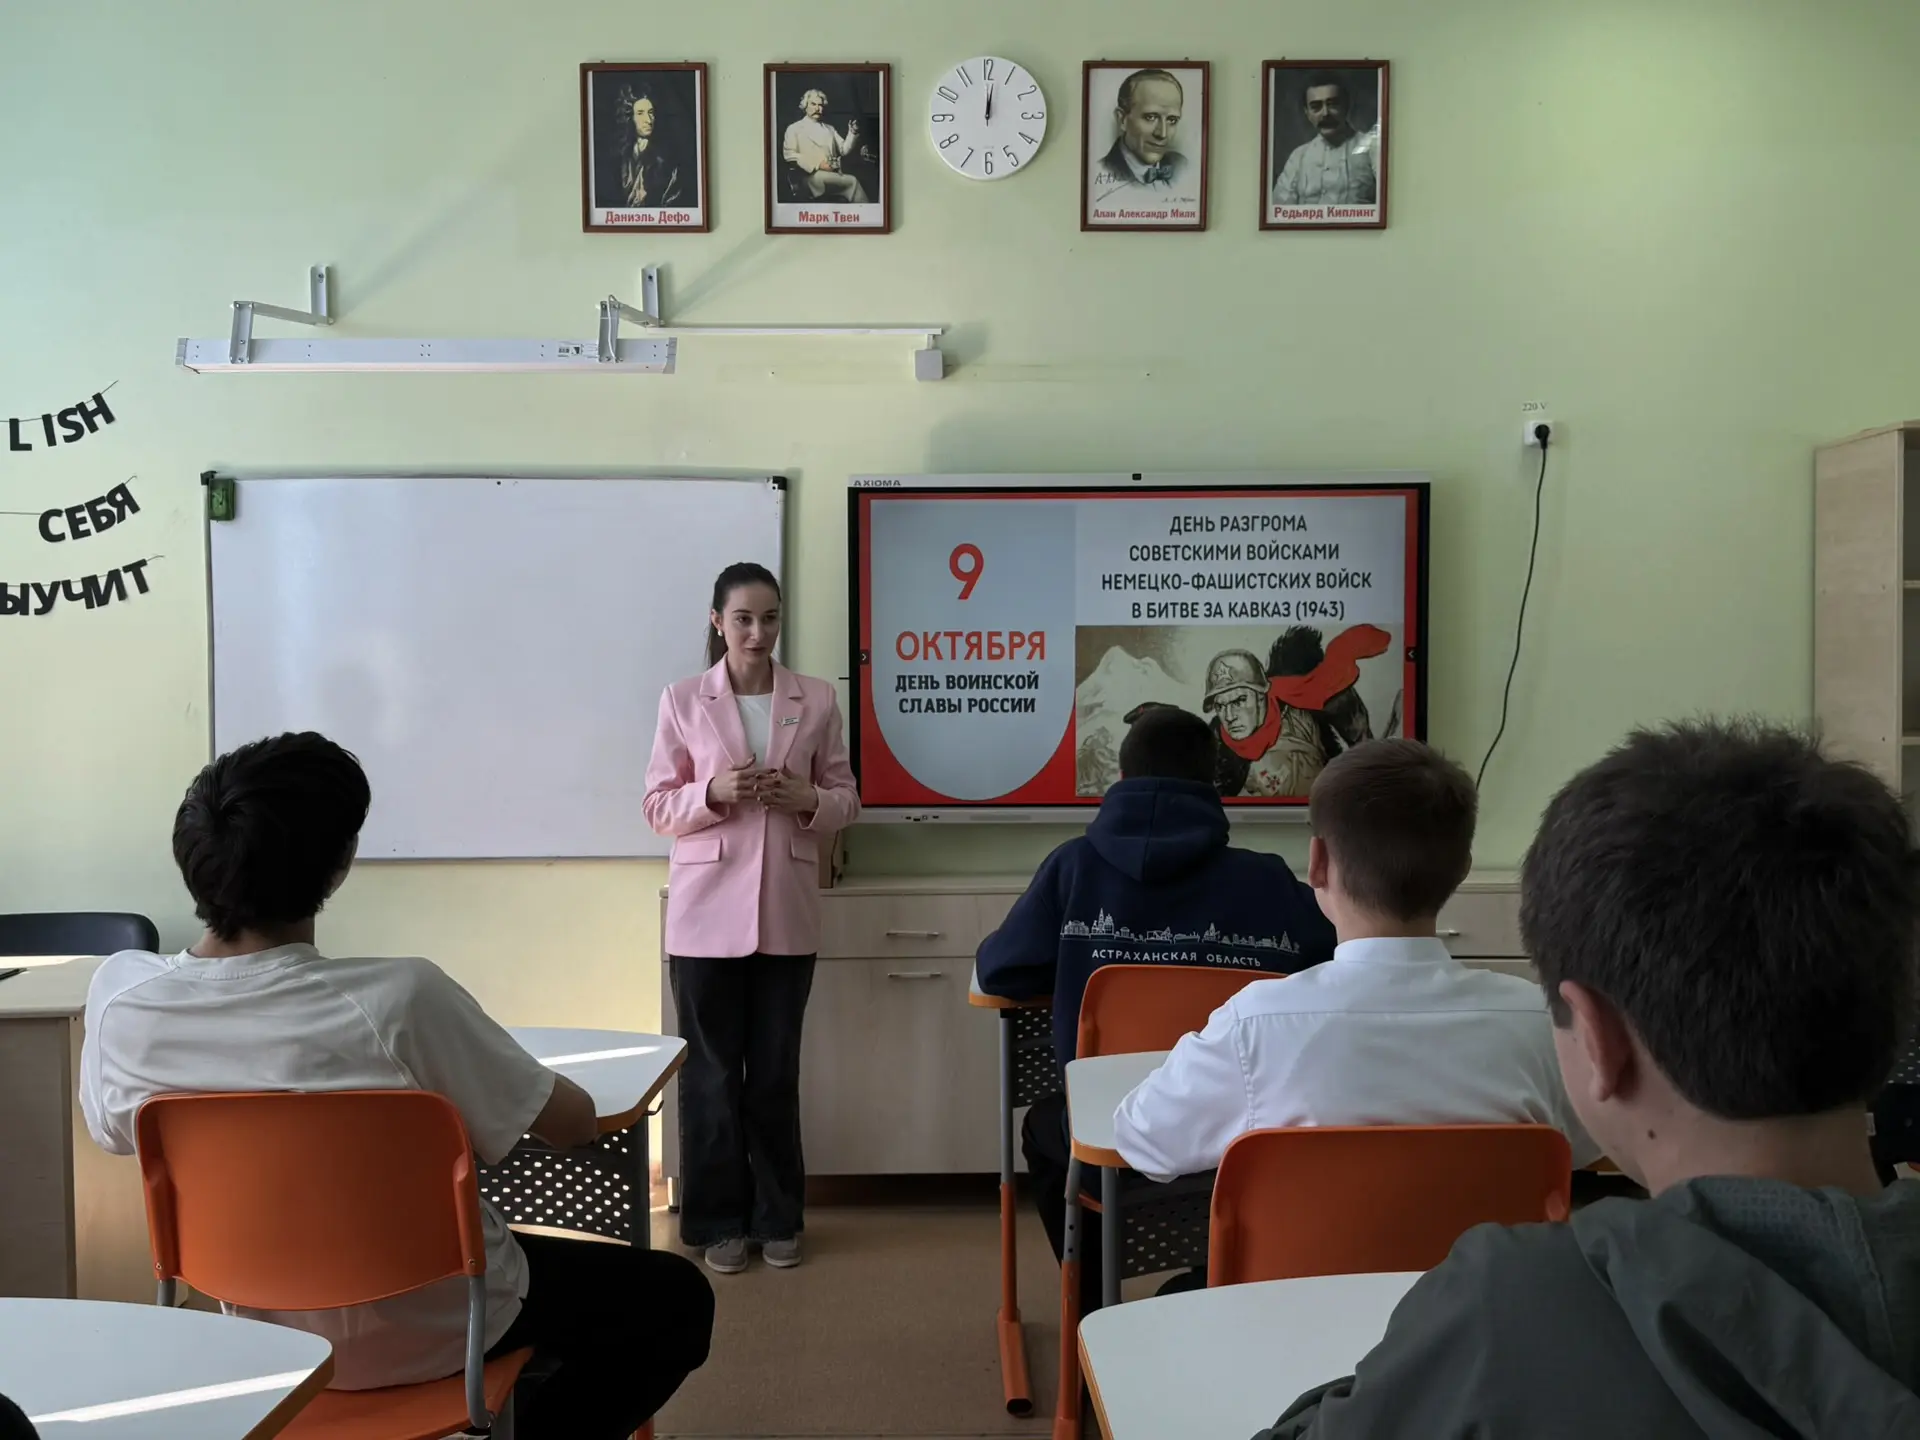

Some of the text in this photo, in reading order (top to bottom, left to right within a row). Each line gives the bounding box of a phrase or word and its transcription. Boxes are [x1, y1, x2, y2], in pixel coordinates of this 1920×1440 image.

[956, 66, 973, 88] 11
[983, 59, 995, 81] 12
[1004, 66, 1016, 85] 1
[937, 86, 959, 104] 10
[1017, 84, 1037, 101] 2
[931, 113, 955, 123] 9
[1020, 111, 1045, 120] 3
[939, 133, 959, 149] 8
[1018, 132, 1038, 144] 4
[960, 147, 974, 168] 7
[984, 151, 993, 175] 6
[1002, 145, 1019, 167] 5
[605, 211, 690, 224] Даниэль Дефо
[798, 211, 860, 224] Марк Твен
[1093, 209, 1196, 219] Алан Александр Милн
[1274, 206, 1376, 219] Редьярд Киплинг
[1522, 402, 1538, 411] 220
[853, 479, 902, 487] AXIOMA
[38, 482, 141, 543] СЕБЯ
[1169, 515, 1308, 536] ДЕНЬ РАЗГРОМА
[1129, 539, 1340, 562] СОВЕТСКИМИ ВОЙСКАМИ
[949, 543, 984, 600] 9
[1101, 567, 1373, 592] НЕМЕЦКО-ФАШИСТСКИХ ВОЙСК
[1131, 600, 1346, 621] В БИТВЕ ЗА КАВКАЗ (1943)
[895, 630, 1046, 661] ОКТЯБРЯ
[895, 670, 1040, 692] ДЕНЬ ВОИНСКОЙ
[898, 697, 1037, 714] СЛАВЫ РОССИИ
[1091, 949, 1261, 967] АСТРАХАНСКАЯ ОБЛАСТЬ
